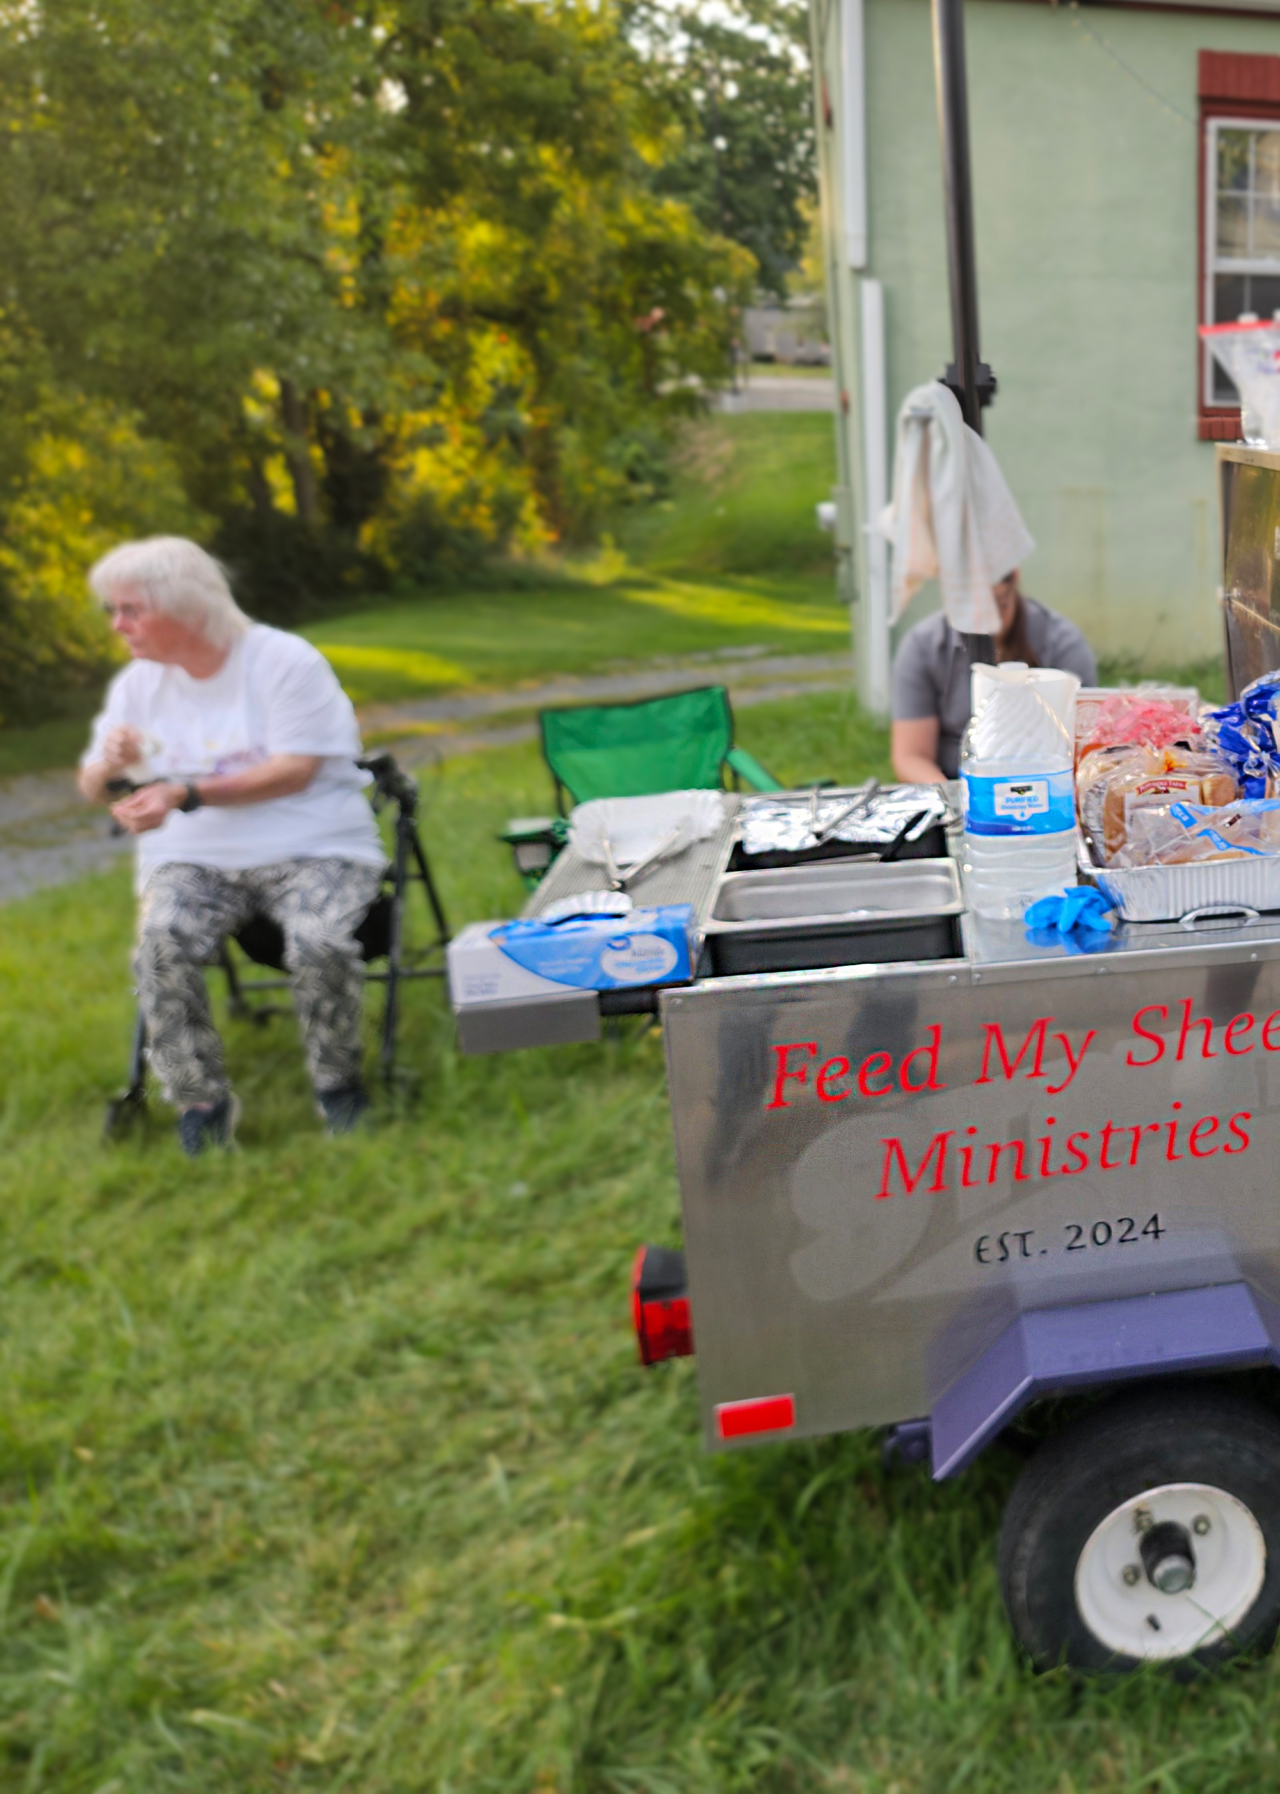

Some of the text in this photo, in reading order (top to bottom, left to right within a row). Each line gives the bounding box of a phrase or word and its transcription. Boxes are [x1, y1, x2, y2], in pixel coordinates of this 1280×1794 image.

[764, 1023, 947, 1111] Feed
[973, 1016, 1098, 1095] My
[874, 1101, 1253, 1200] Ministries
[974, 1213, 1166, 1264] EST. 2024
